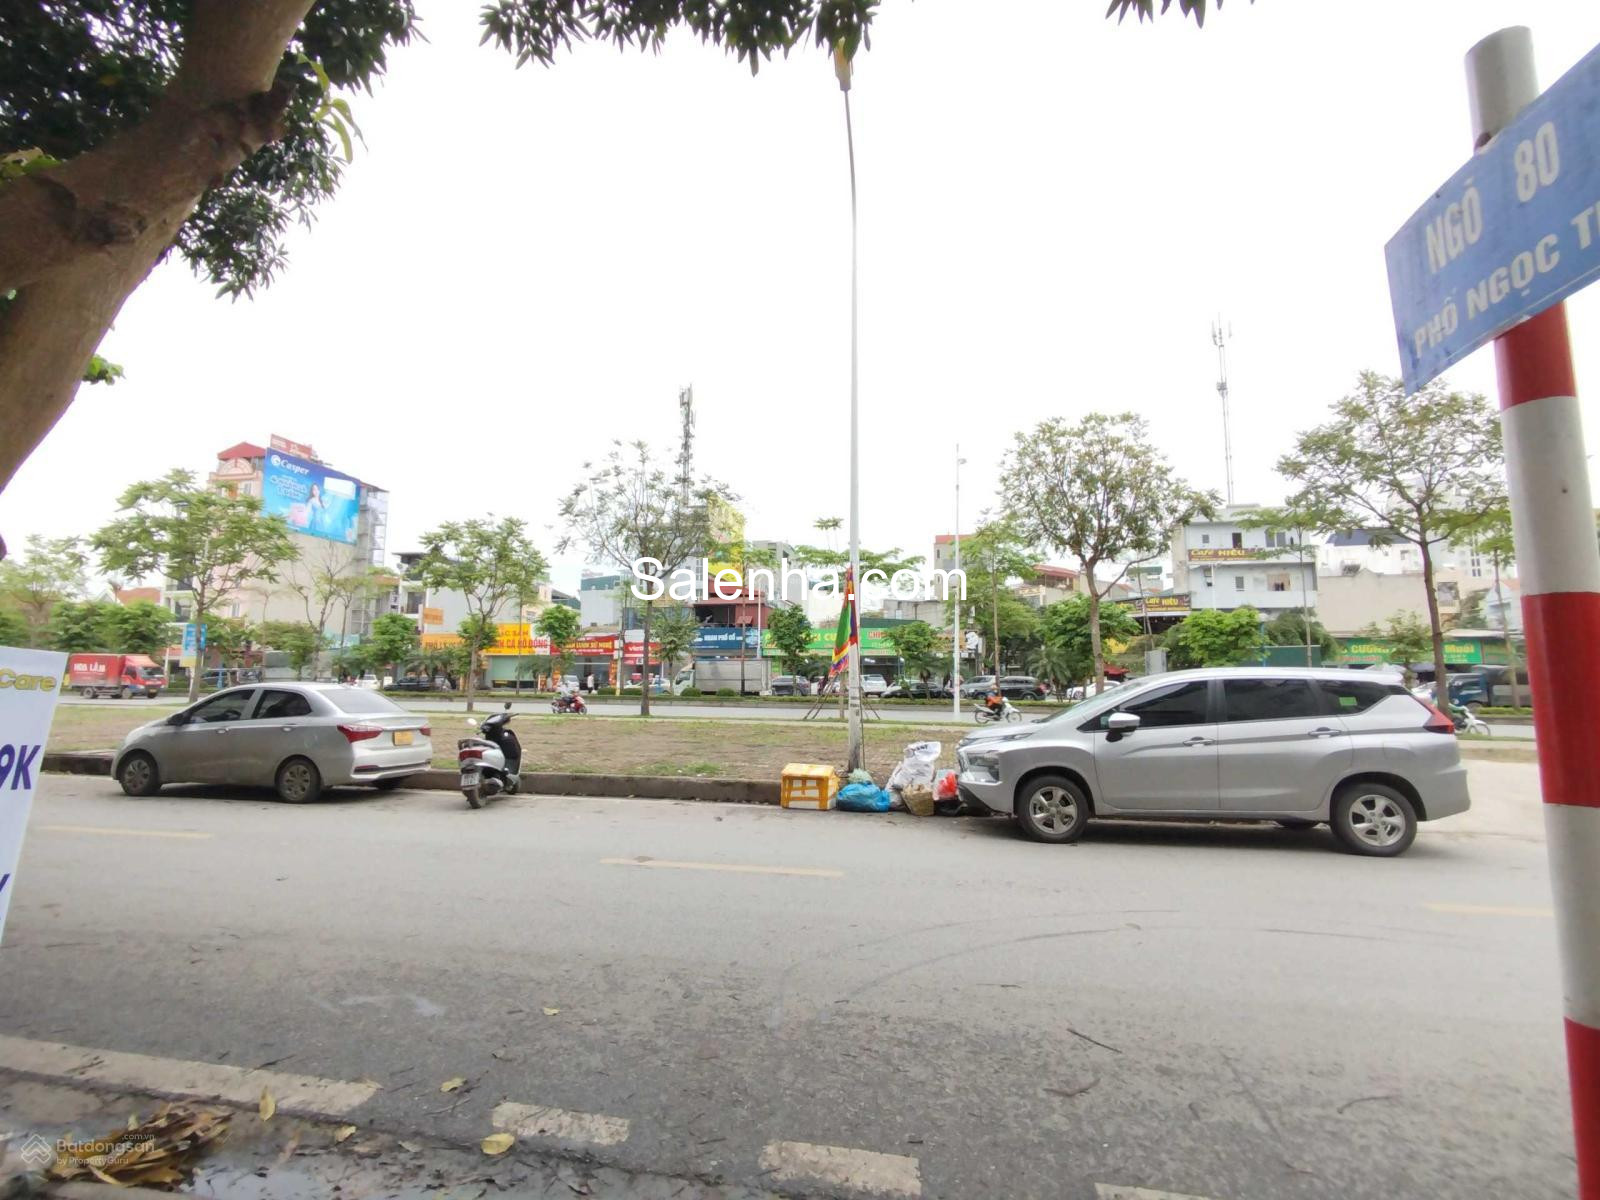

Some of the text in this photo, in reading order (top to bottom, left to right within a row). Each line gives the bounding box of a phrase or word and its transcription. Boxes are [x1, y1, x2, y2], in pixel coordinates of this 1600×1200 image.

[1425, 121, 1560, 275] NGÕ 80
[1414, 285, 1458, 359] PHỐ
[1466, 234, 1560, 320] NGỌC
[280, 458, 310, 475] Casper
[0, 667, 57, 692] Care
